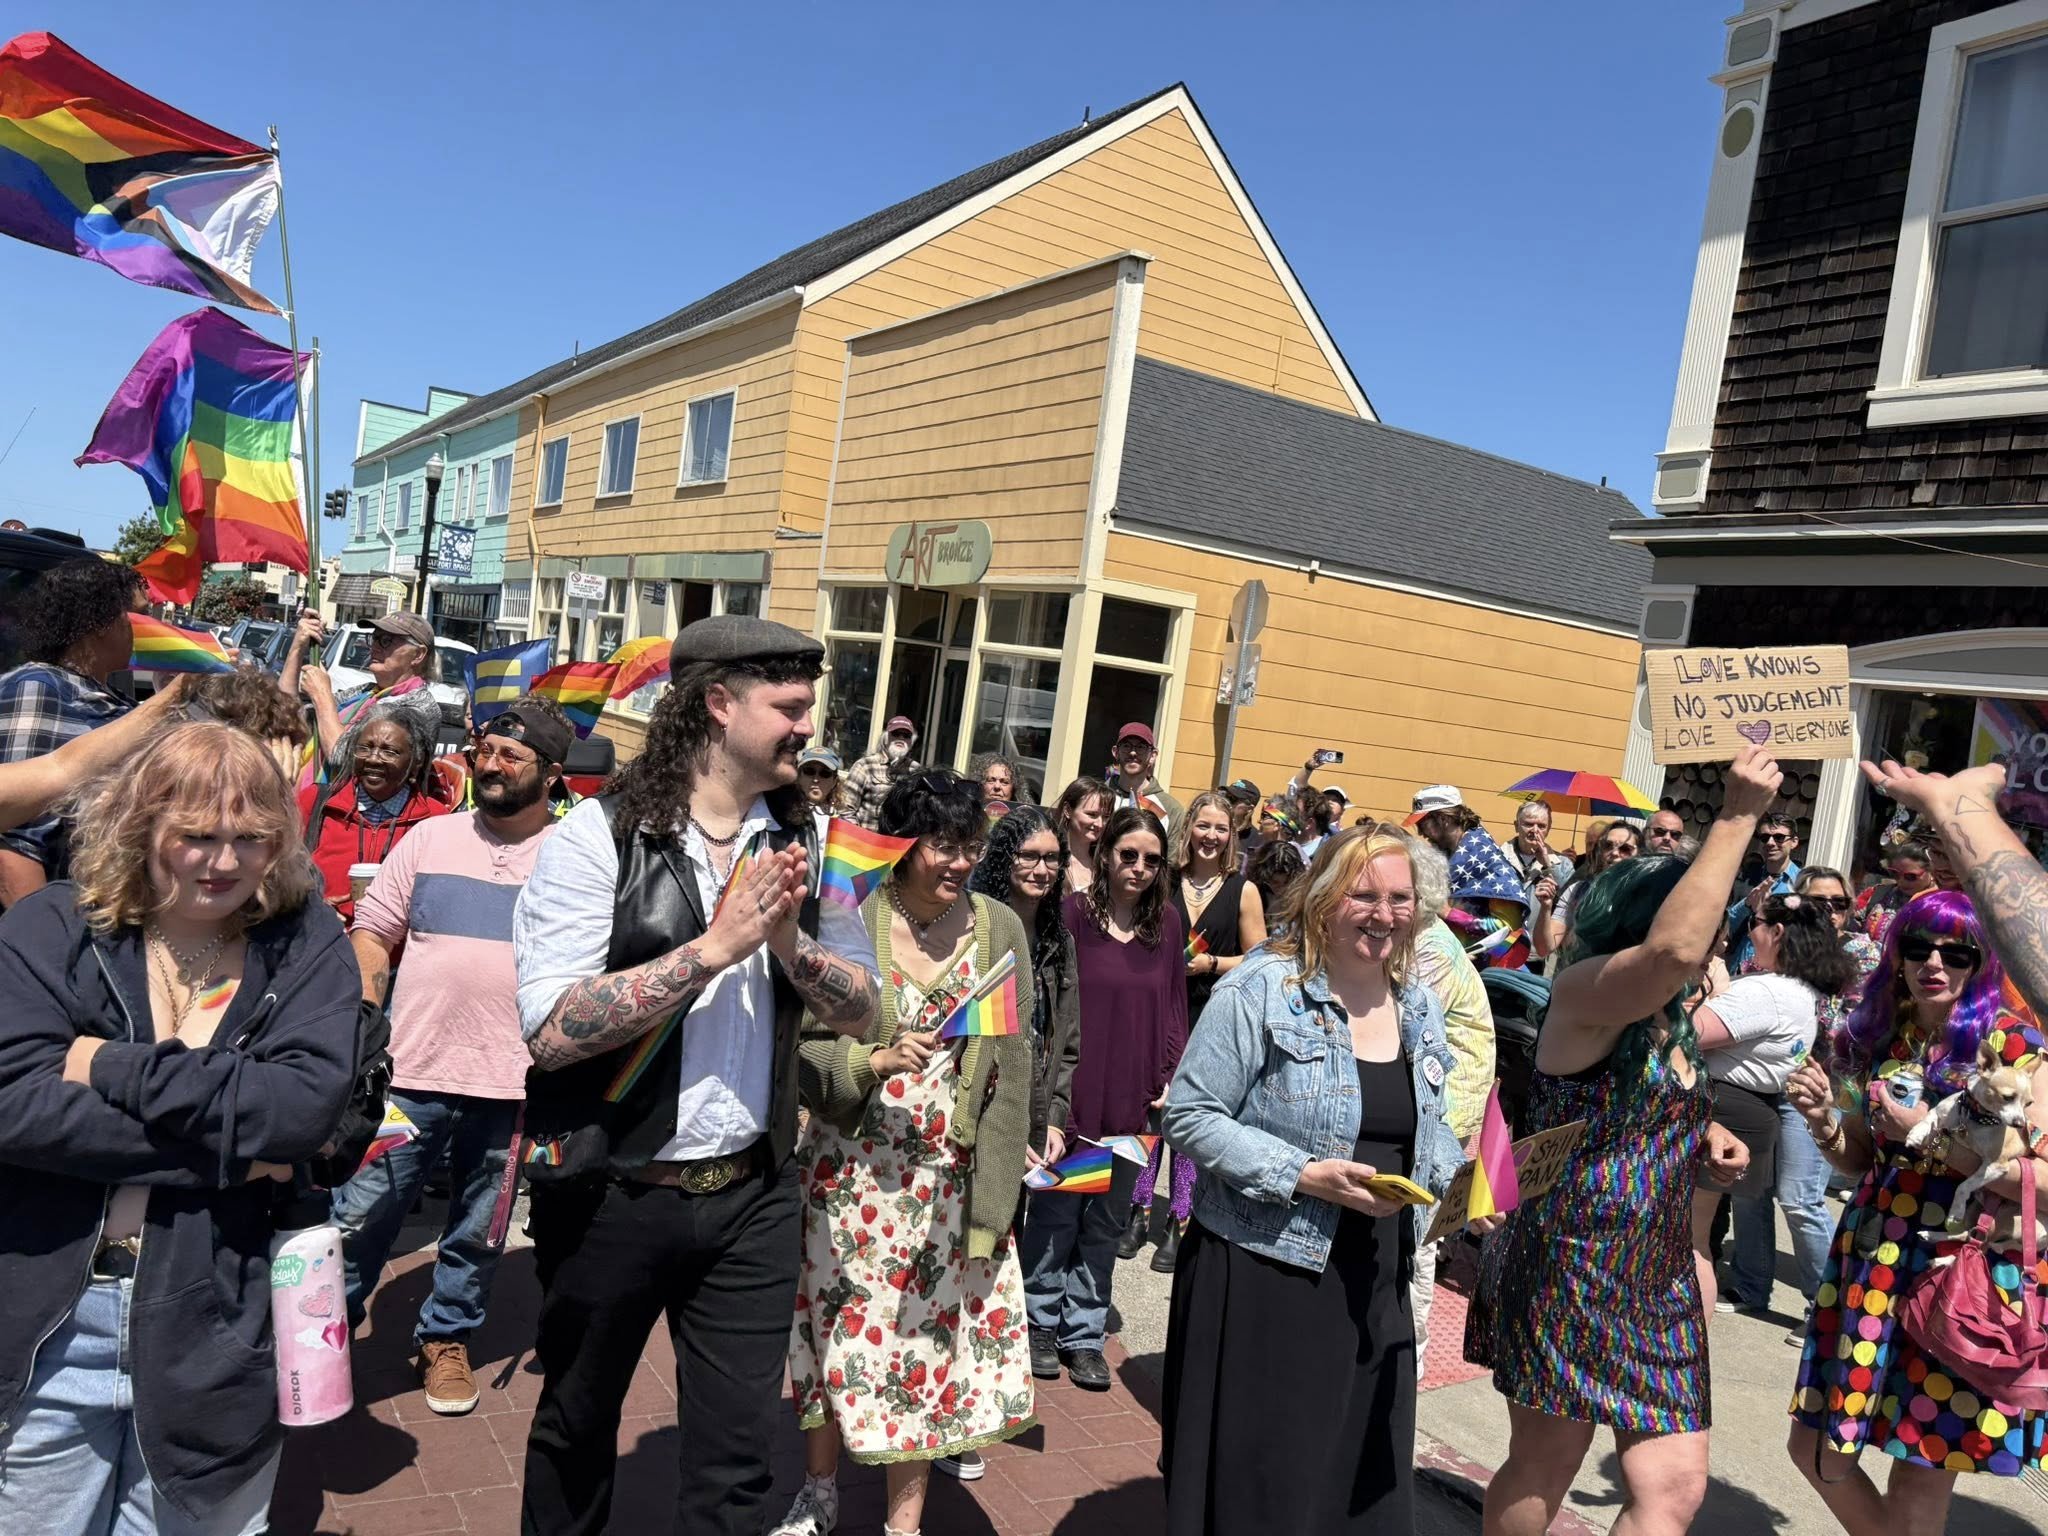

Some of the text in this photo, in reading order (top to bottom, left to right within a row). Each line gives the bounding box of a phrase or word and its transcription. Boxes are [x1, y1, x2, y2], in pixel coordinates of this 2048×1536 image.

[897, 520, 958, 591] ART
[1674, 653, 1821, 684] LOVE KNOWS
[1673, 684, 1848, 721] NO JUDGEMENT
[1664, 719, 1851, 750] LOVE EVERYONE
[501, 1155, 516, 1193] CAMINO
